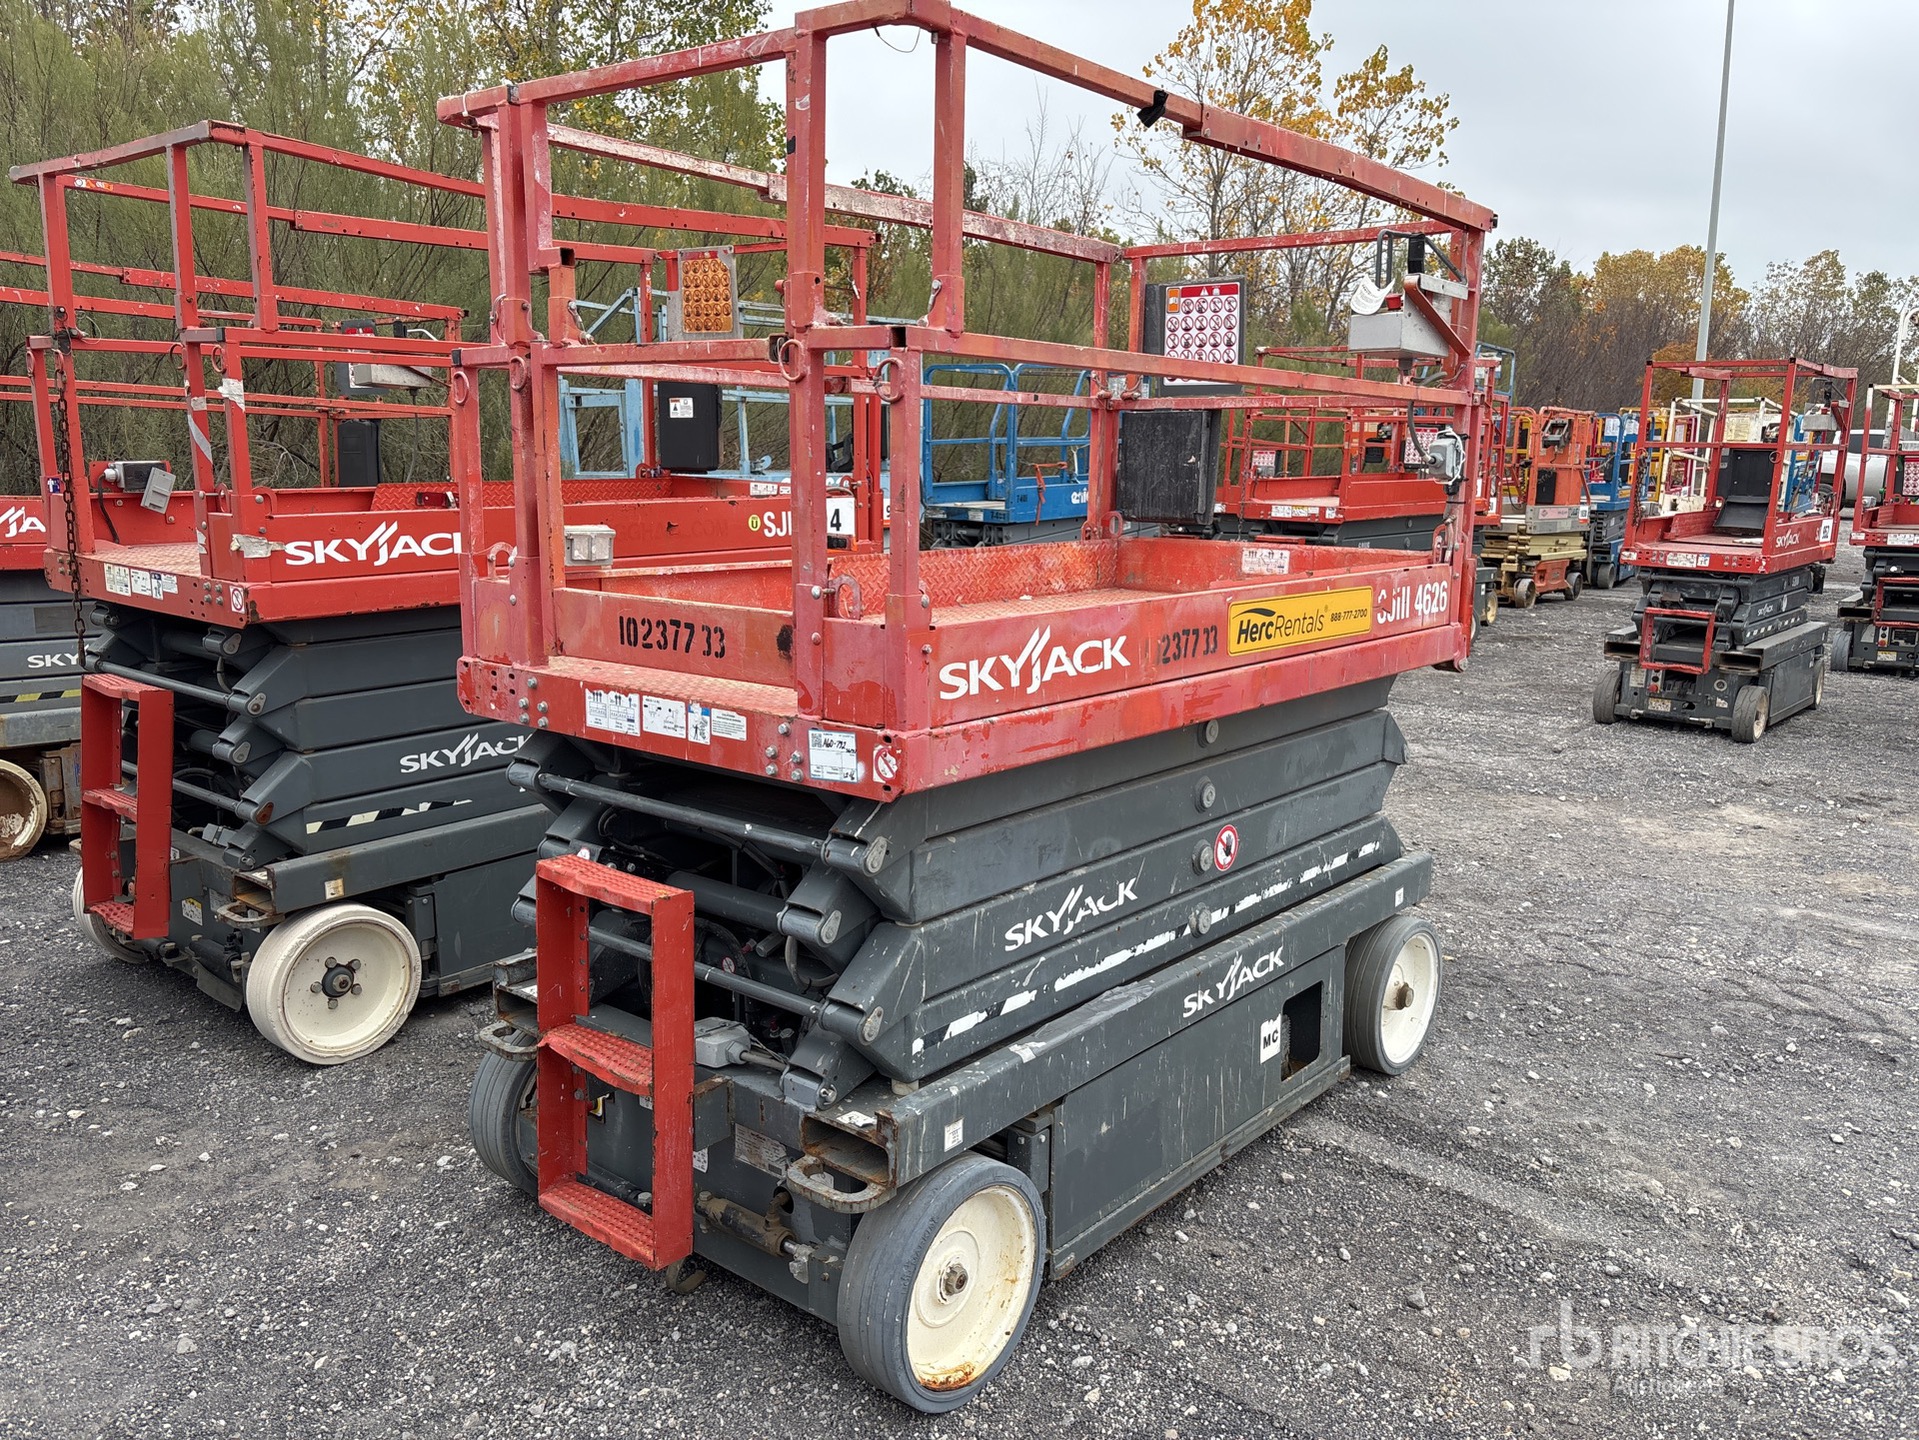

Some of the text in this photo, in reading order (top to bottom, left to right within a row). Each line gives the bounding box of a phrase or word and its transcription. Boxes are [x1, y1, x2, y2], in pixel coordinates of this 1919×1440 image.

[1414, 580, 1448, 616] 4626
[1237, 608, 1368, 645] HercRentals 888-777-2700
[938, 624, 1131, 700] SKYJACK
[1005, 877, 1138, 951] SKYJACK
[1183, 945, 1285, 1018] SKYJACK
[1263, 1029, 1279, 1049] MC
